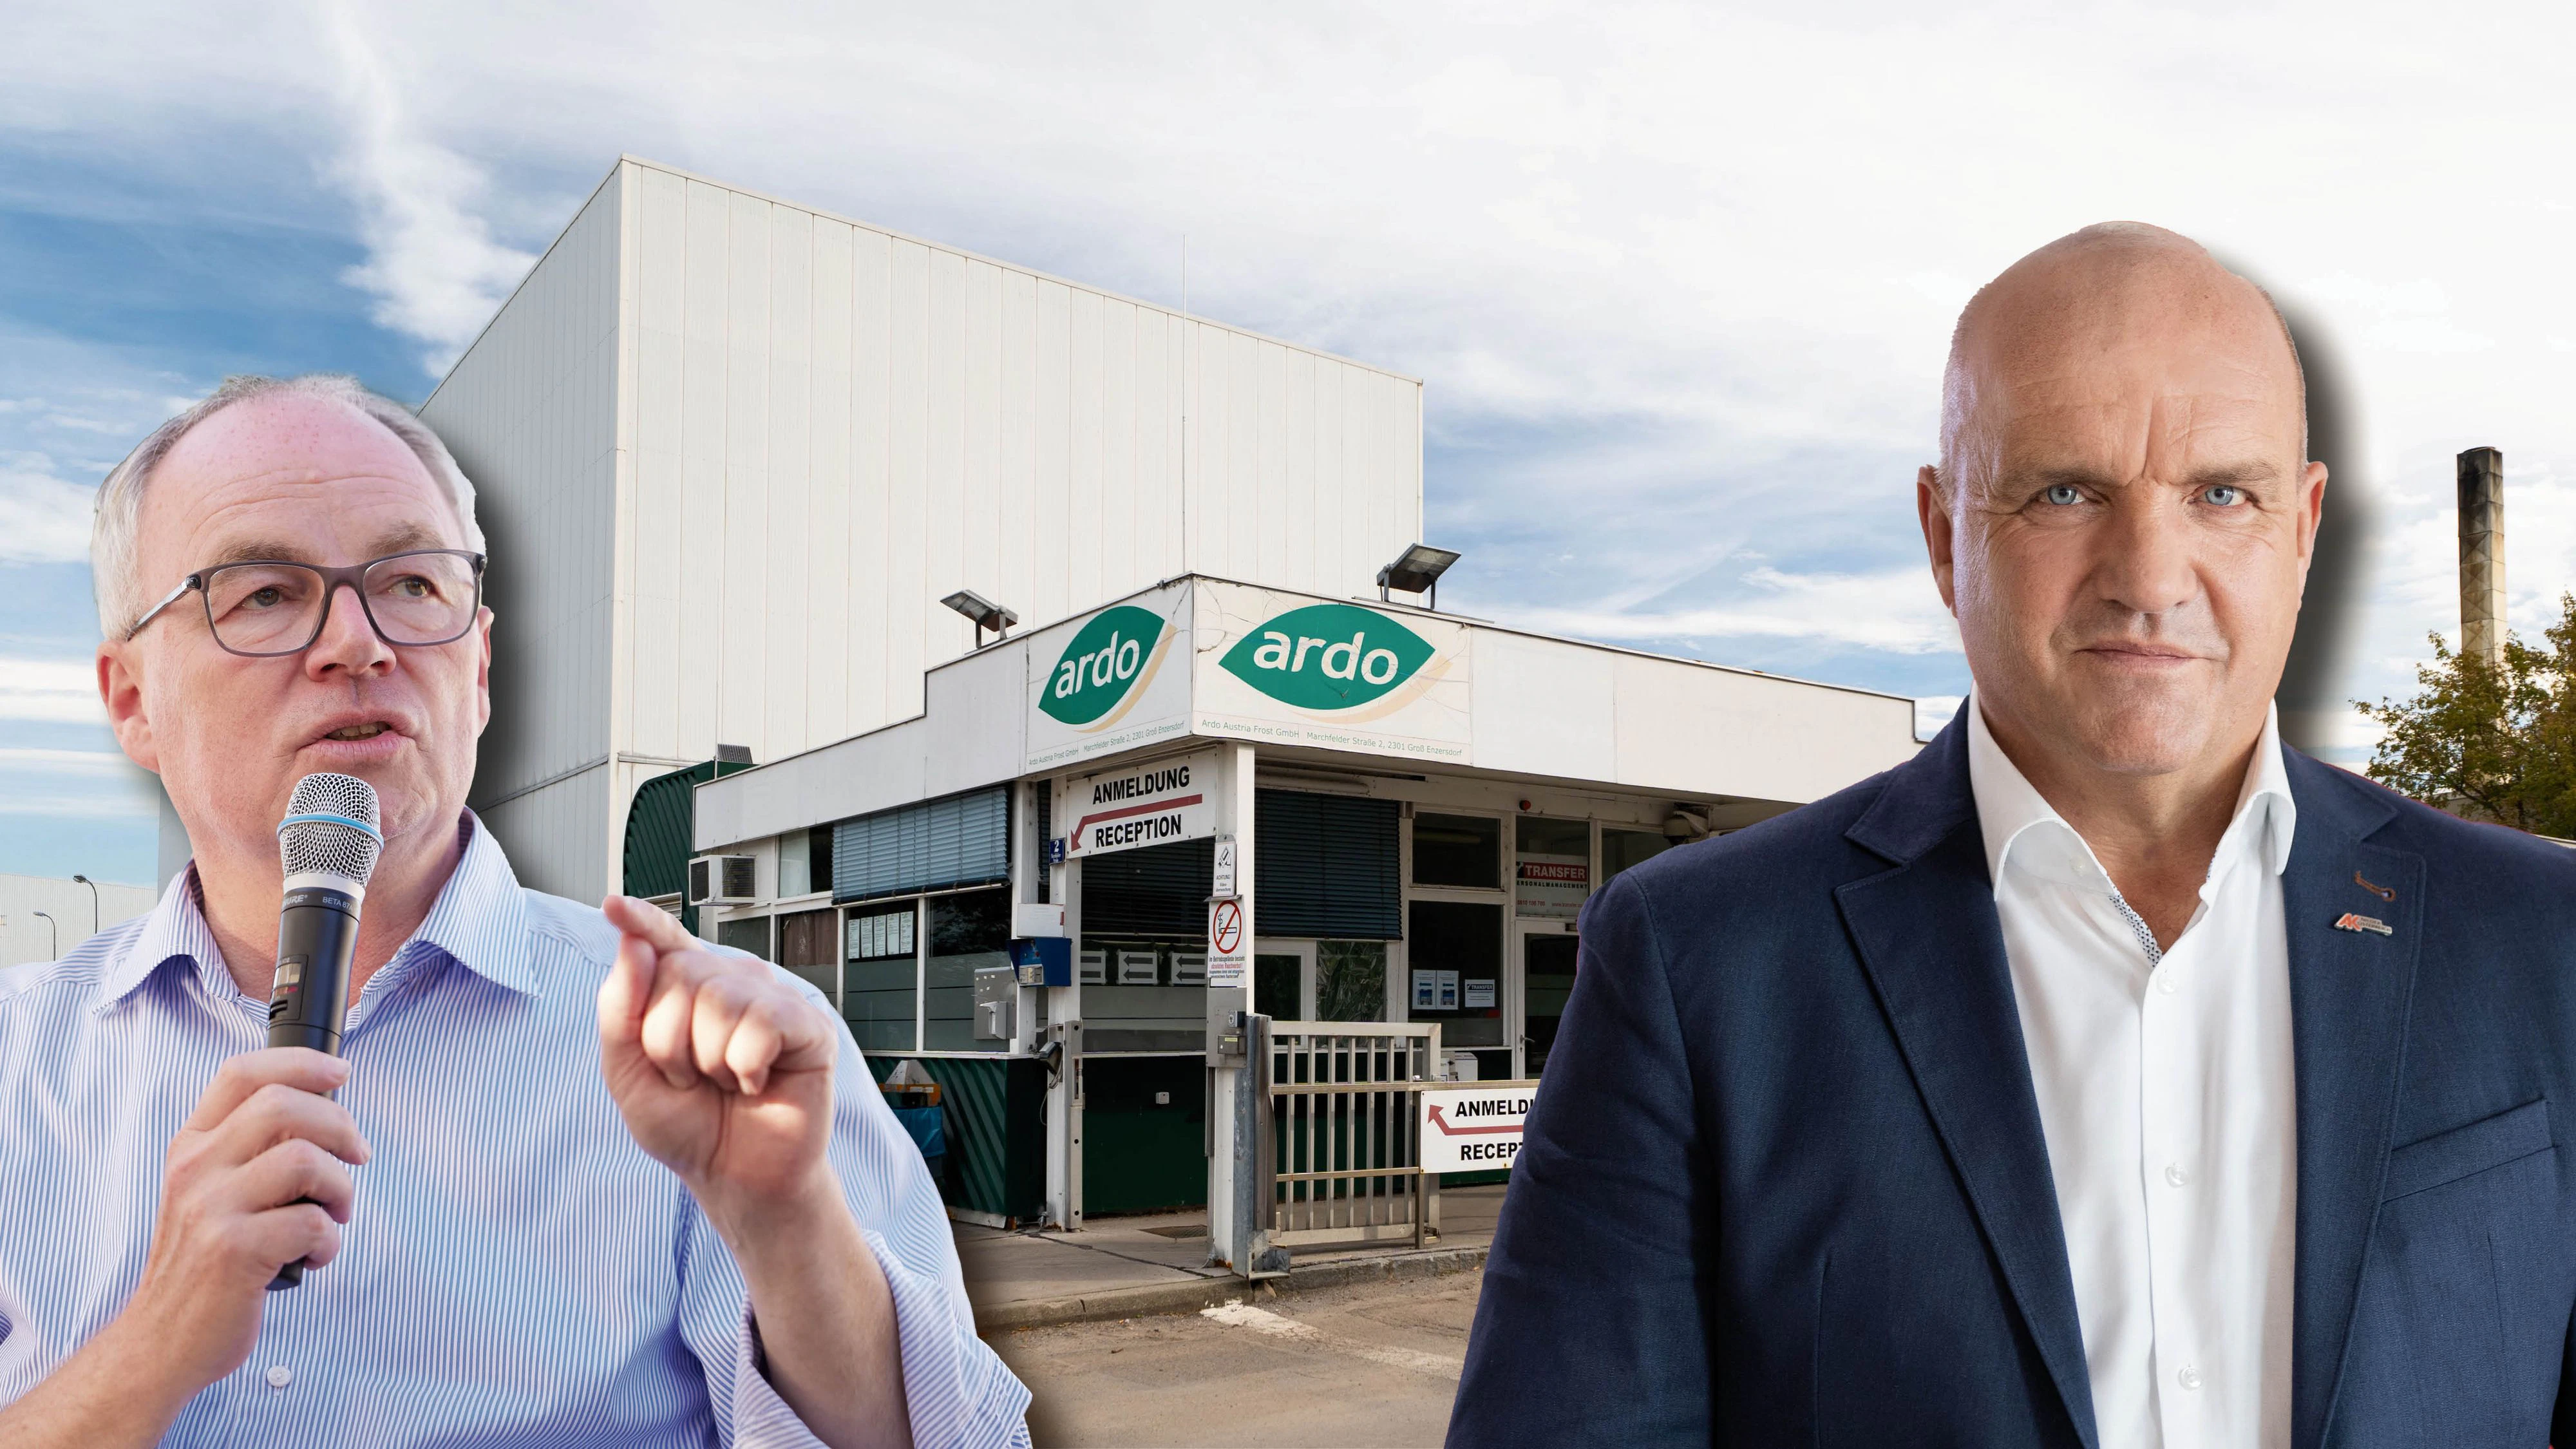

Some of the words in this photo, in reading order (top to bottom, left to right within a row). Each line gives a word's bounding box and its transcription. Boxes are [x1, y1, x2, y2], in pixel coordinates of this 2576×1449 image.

[1056, 630, 1139, 699] ardo
[1253, 631, 1398, 685] ardo
[1083, 740, 1110, 752] Marchfelder
[1110, 736, 1126, 746] Straße
[1126, 734, 1132, 743] 2,
[1132, 731, 1144, 741] 2301
[1145, 728, 1157, 737] Groß
[1159, 720, 1185, 734] Enzersdorf
[1202, 719, 1220, 729] Ardo
[1223, 722, 1251, 732] Austria
[1254, 725, 1273, 735] Frost
[1276, 728, 1299, 738] GmbH
[1307, 732, 1350, 744] Marchfelder
[1352, 737, 1376, 747] Straße
[1378, 741, 1385, 749] 2,
[1388, 741, 1405, 750] 2301
[1408, 744, 1425, 752] Groß
[1426, 746, 1463, 757] Enzersdorf
[1039, 754, 1054, 764] Austria
[1065, 748, 1079, 757] GmbH
[1093, 766, 1190, 805] ANMELDUNG
[1096, 814, 1182, 848] RECEPTION
[1054, 840, 1059, 853] 2
[1525, 865, 1586, 879] TRANSFER
[1516, 880, 1587, 889] ERSONALMANAGEMENT
[323, 896, 341, 907] BETA
[2338, 914, 2361, 931] AK
[1455, 1099, 1533, 1117] ANMELD
